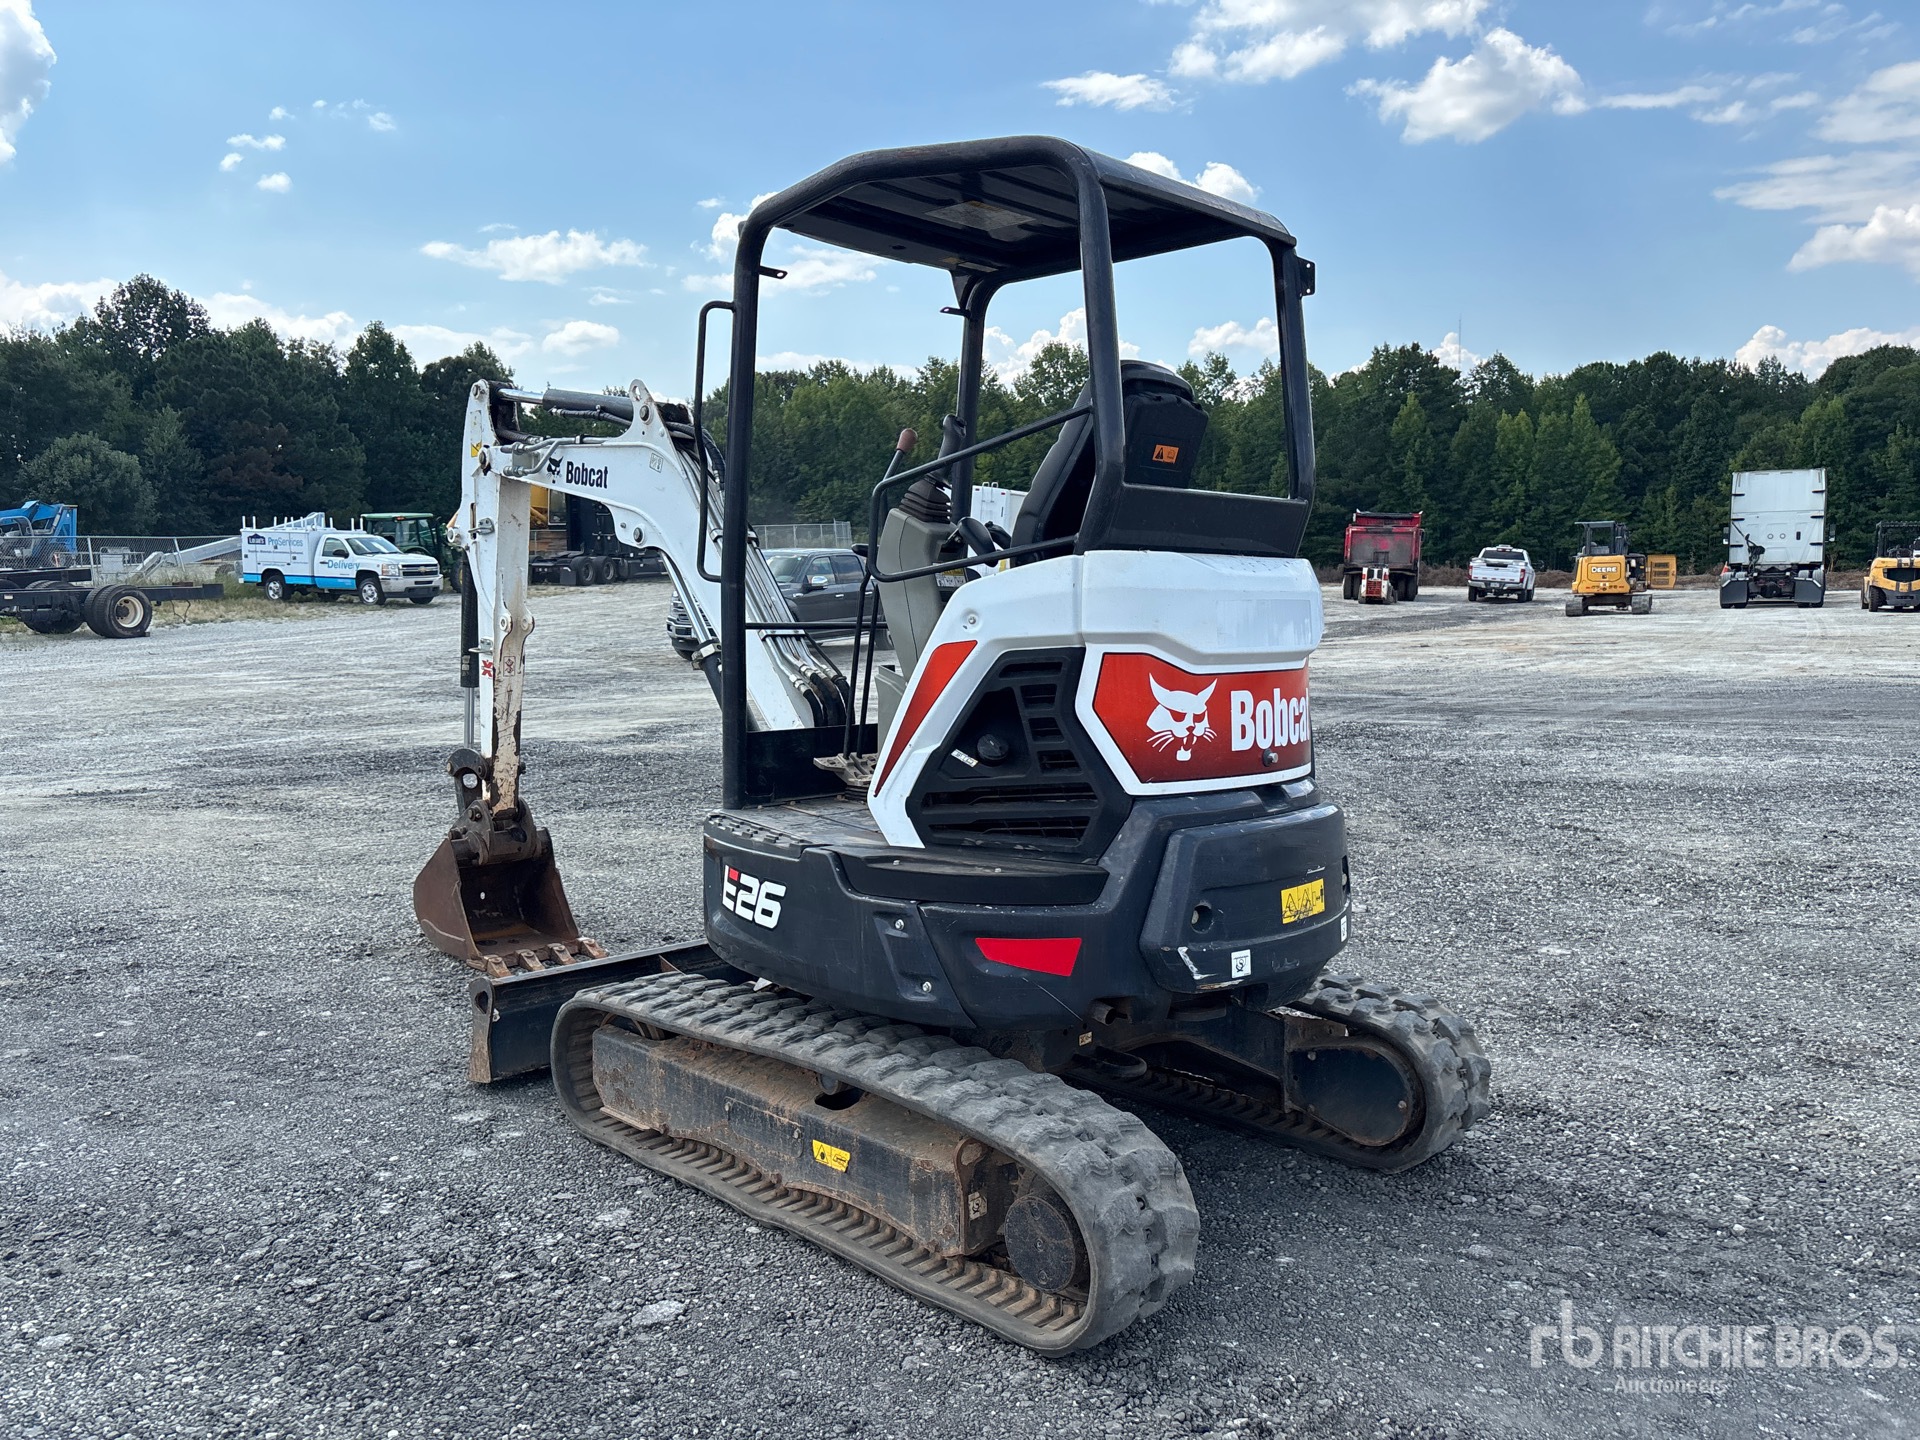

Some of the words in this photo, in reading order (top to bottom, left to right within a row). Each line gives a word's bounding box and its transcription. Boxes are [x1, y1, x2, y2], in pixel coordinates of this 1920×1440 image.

[566, 461, 608, 489] Bobcat
[267, 536, 304, 547] ProServices
[327, 559, 361, 570] Delivery
[722, 864, 787, 929] E26
